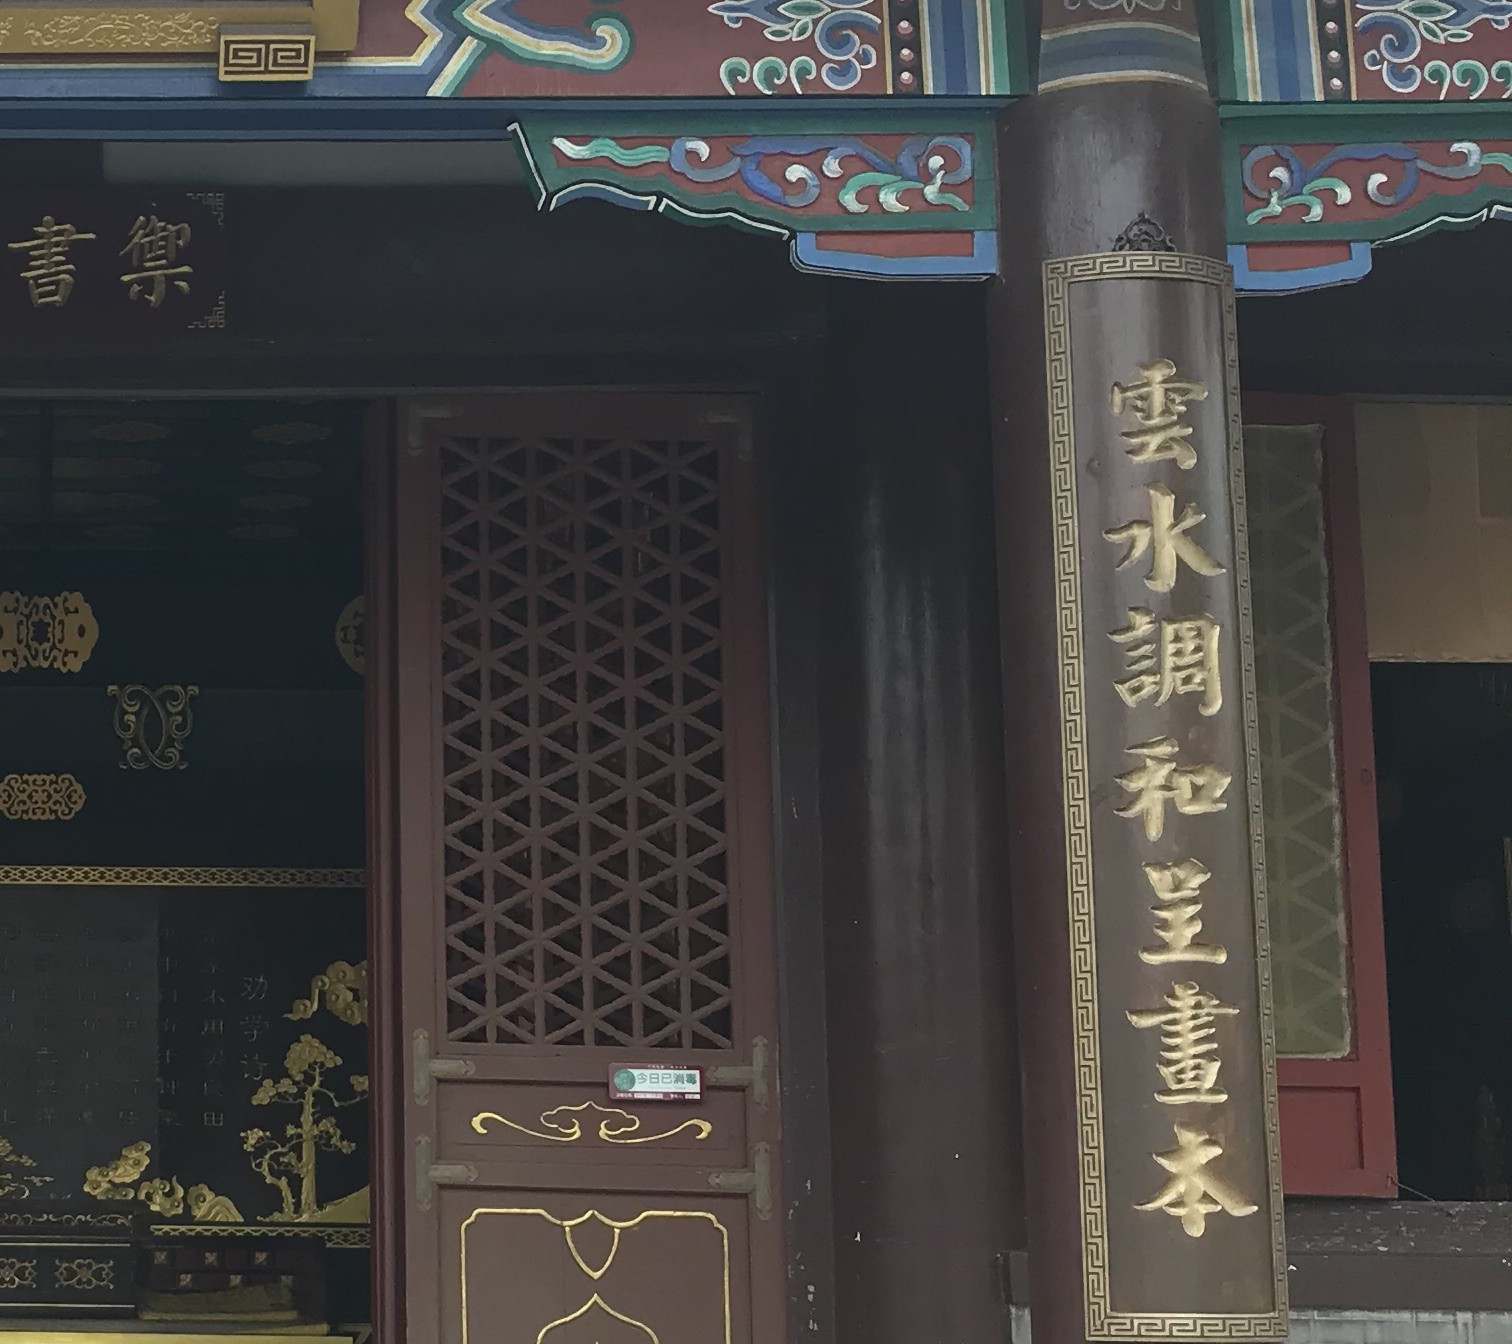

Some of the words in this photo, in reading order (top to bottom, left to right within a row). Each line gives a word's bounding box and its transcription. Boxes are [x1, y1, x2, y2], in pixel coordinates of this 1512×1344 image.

[240, 973, 269, 1081] 劝学诗
[1102, 358, 1259, 1238] 雲水調和呈畫本
